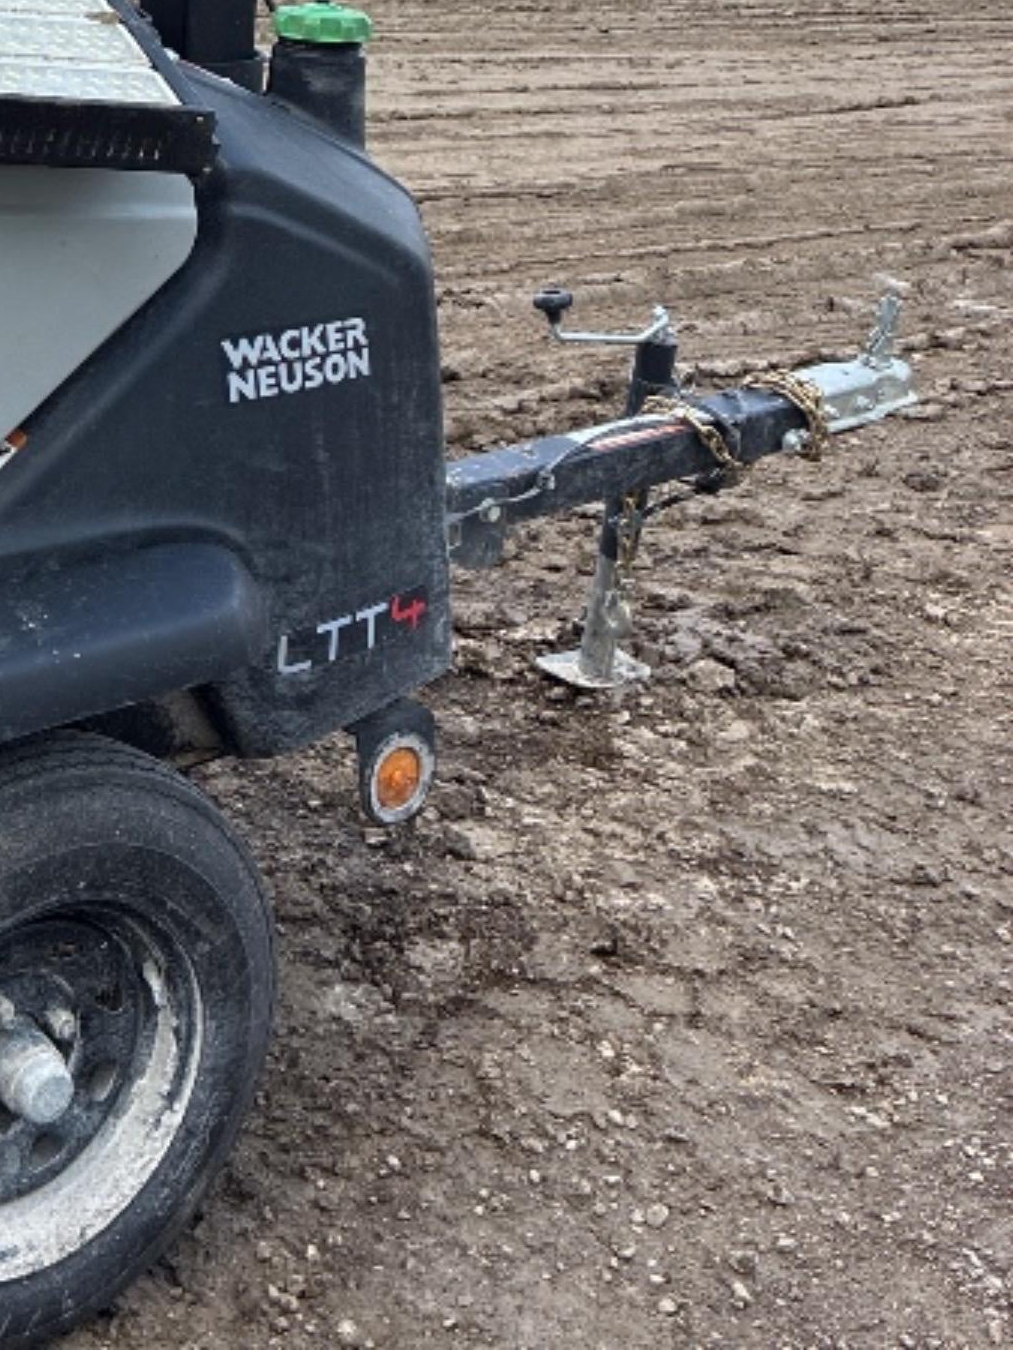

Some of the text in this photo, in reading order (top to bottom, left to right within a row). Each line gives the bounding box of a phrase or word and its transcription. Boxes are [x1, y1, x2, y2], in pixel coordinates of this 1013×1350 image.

[220, 316, 369, 371] WACKER
[227, 348, 371, 403] NEUSON
[277, 594, 428, 675] LTT4
